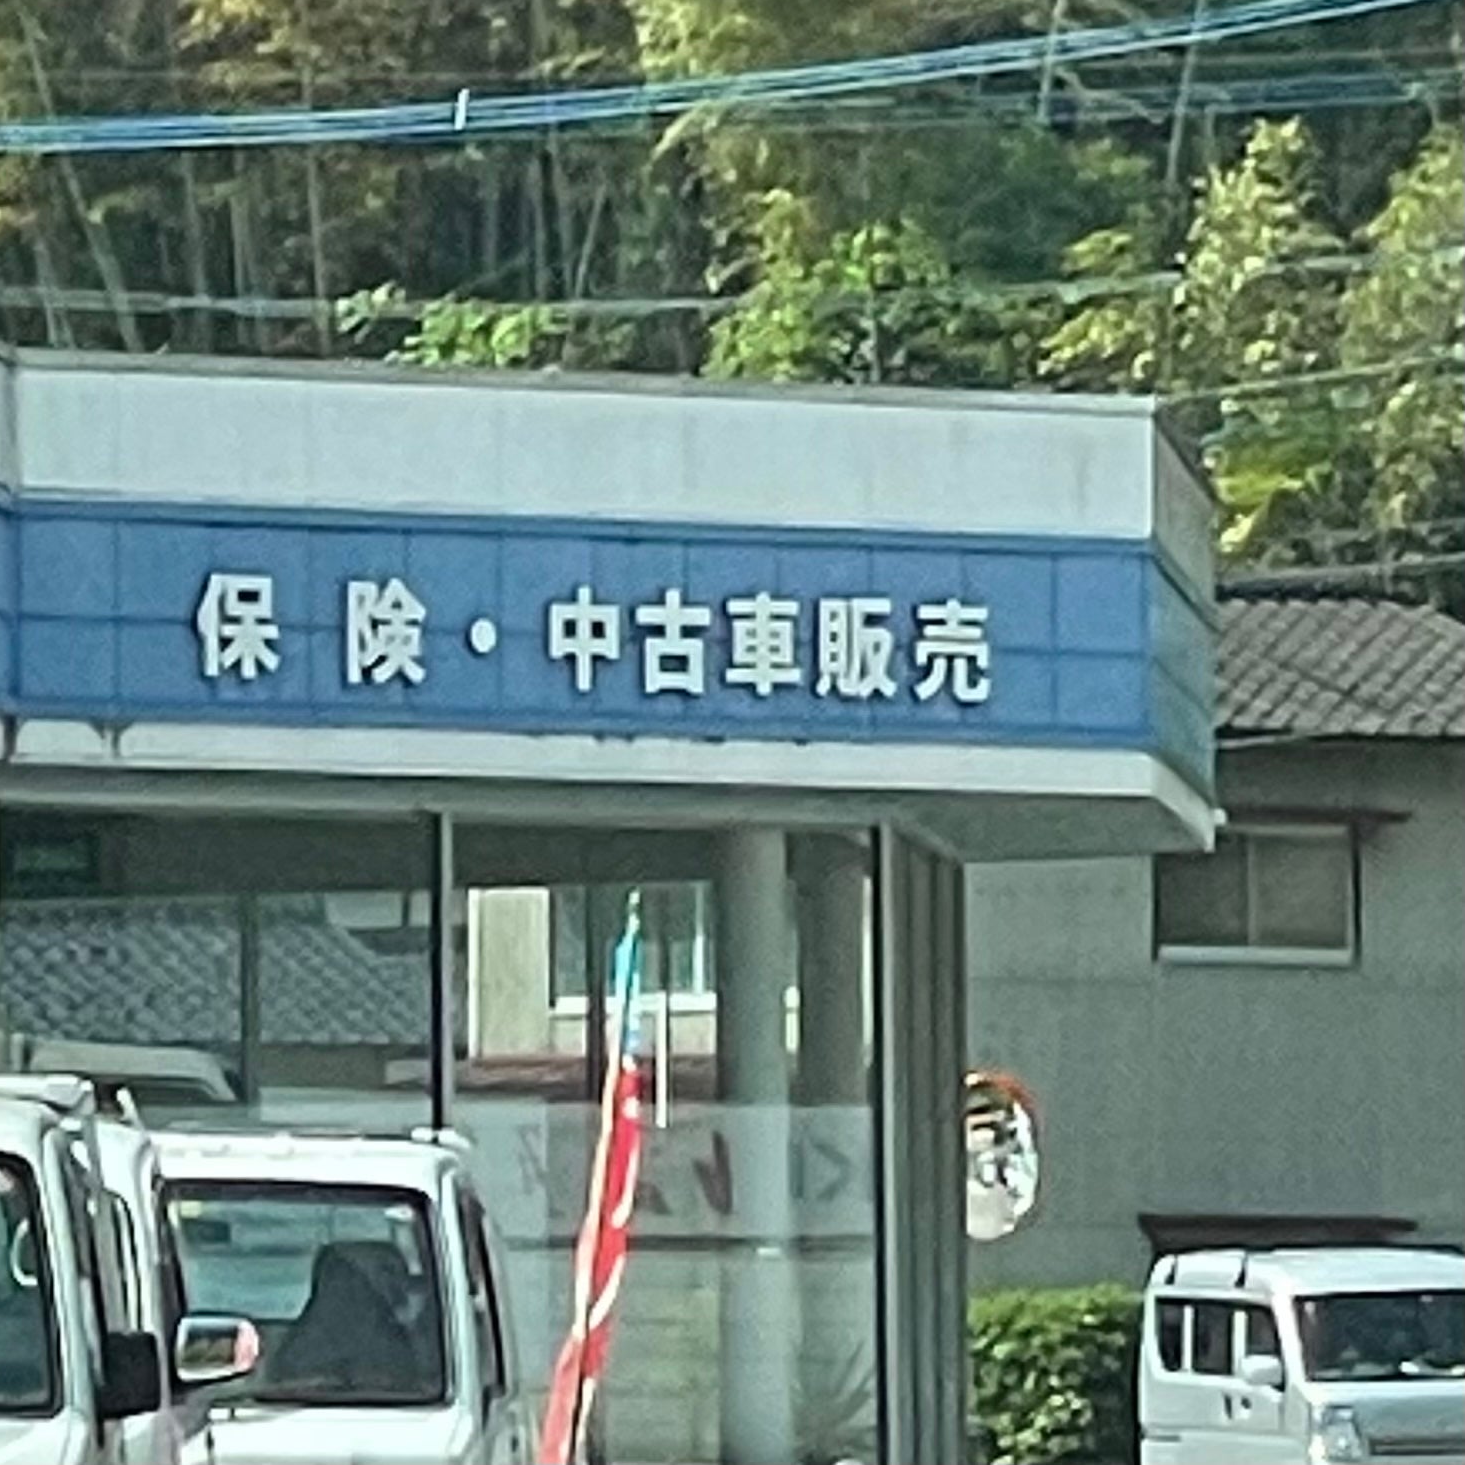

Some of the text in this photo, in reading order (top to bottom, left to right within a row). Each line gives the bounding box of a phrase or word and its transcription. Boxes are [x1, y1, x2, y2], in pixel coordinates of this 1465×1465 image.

[197, 572, 992, 703] 保険・中古車販売
